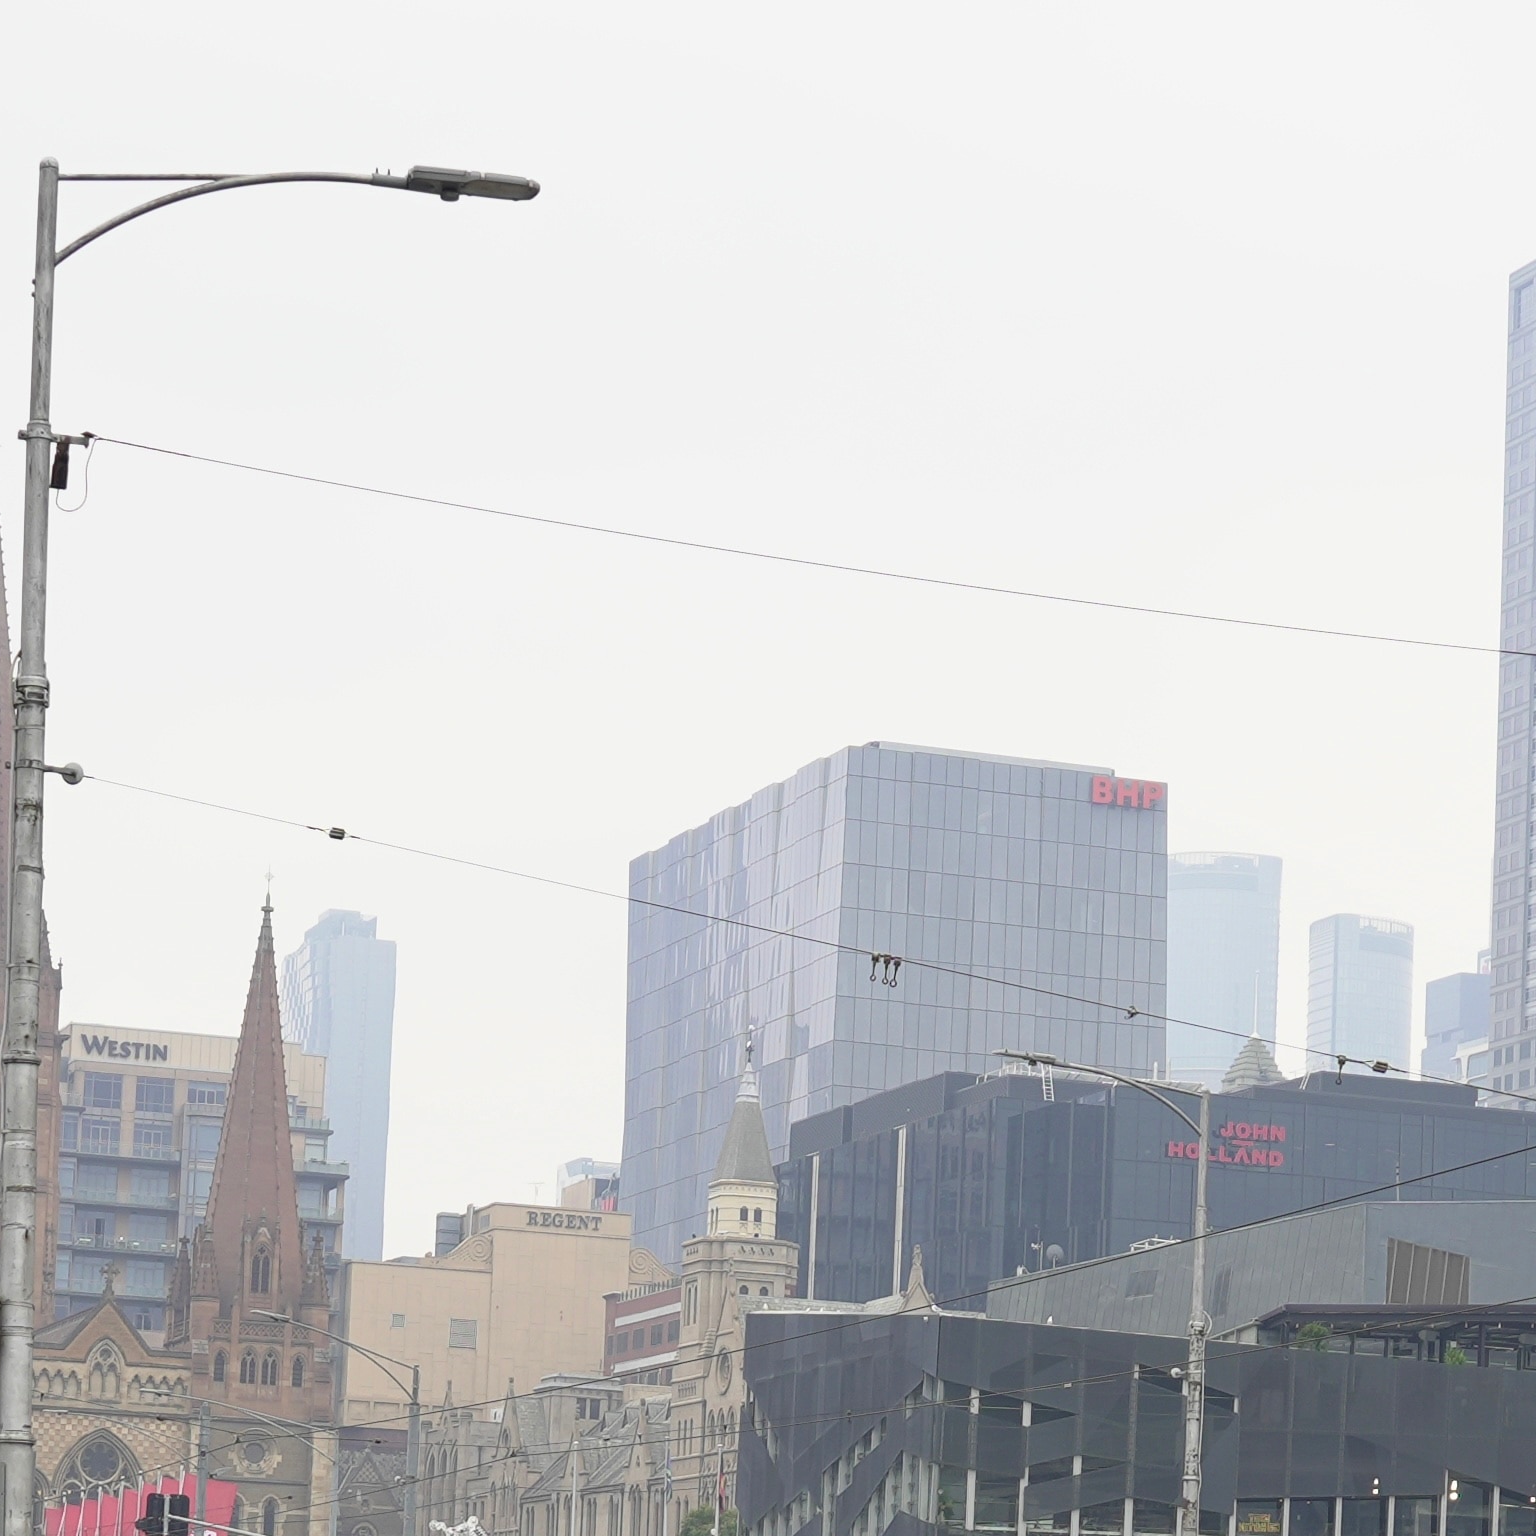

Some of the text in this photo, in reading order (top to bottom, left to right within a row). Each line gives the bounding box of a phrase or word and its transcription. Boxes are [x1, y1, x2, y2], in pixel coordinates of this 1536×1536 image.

[1091, 774, 1163, 809] BHP
[80, 1033, 168, 1061] WESTIN
[1220, 1121, 1286, 1142] JOHN
[526, 1210, 603, 1231] REGENT
